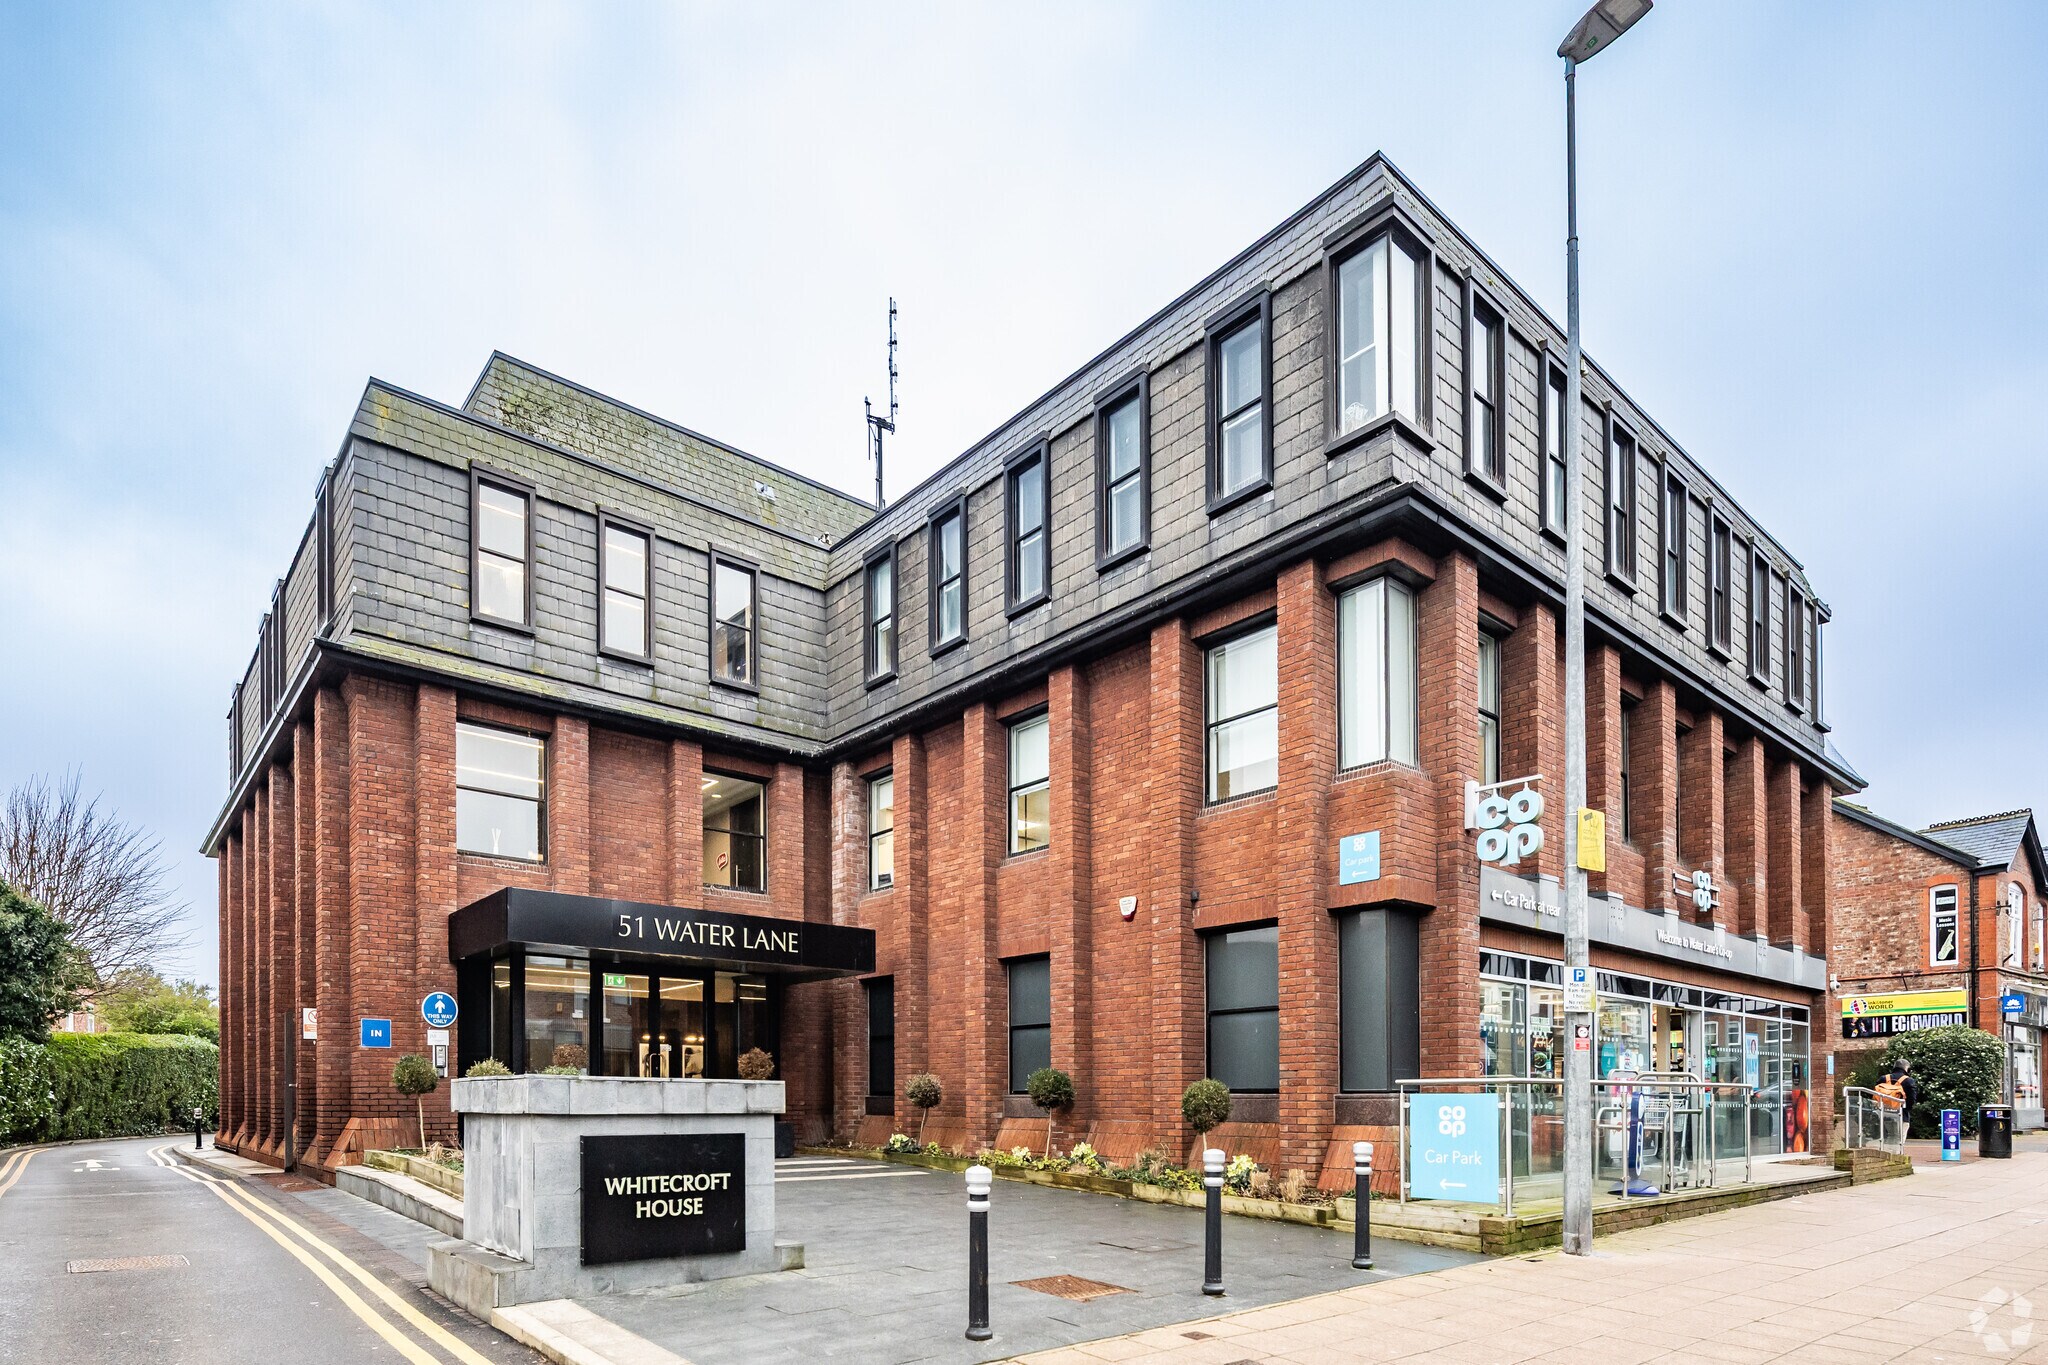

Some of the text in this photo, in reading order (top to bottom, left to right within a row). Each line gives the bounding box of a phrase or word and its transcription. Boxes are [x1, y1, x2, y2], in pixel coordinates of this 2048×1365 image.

[1503, 889, 1561, 917] Car Park at rear
[618, 914, 799, 953] 51 WATER LANE
[1657, 928, 1683, 947] Welcome
[1682, 936, 1689, 949] to
[1689, 936, 1704, 952] Water
[1576, 970, 1584, 981] P
[1424, 1149, 1482, 1165] Car Park
[604, 1172, 731, 1196] WHITECROFT
[636, 1197, 703, 1219] HOUSE
